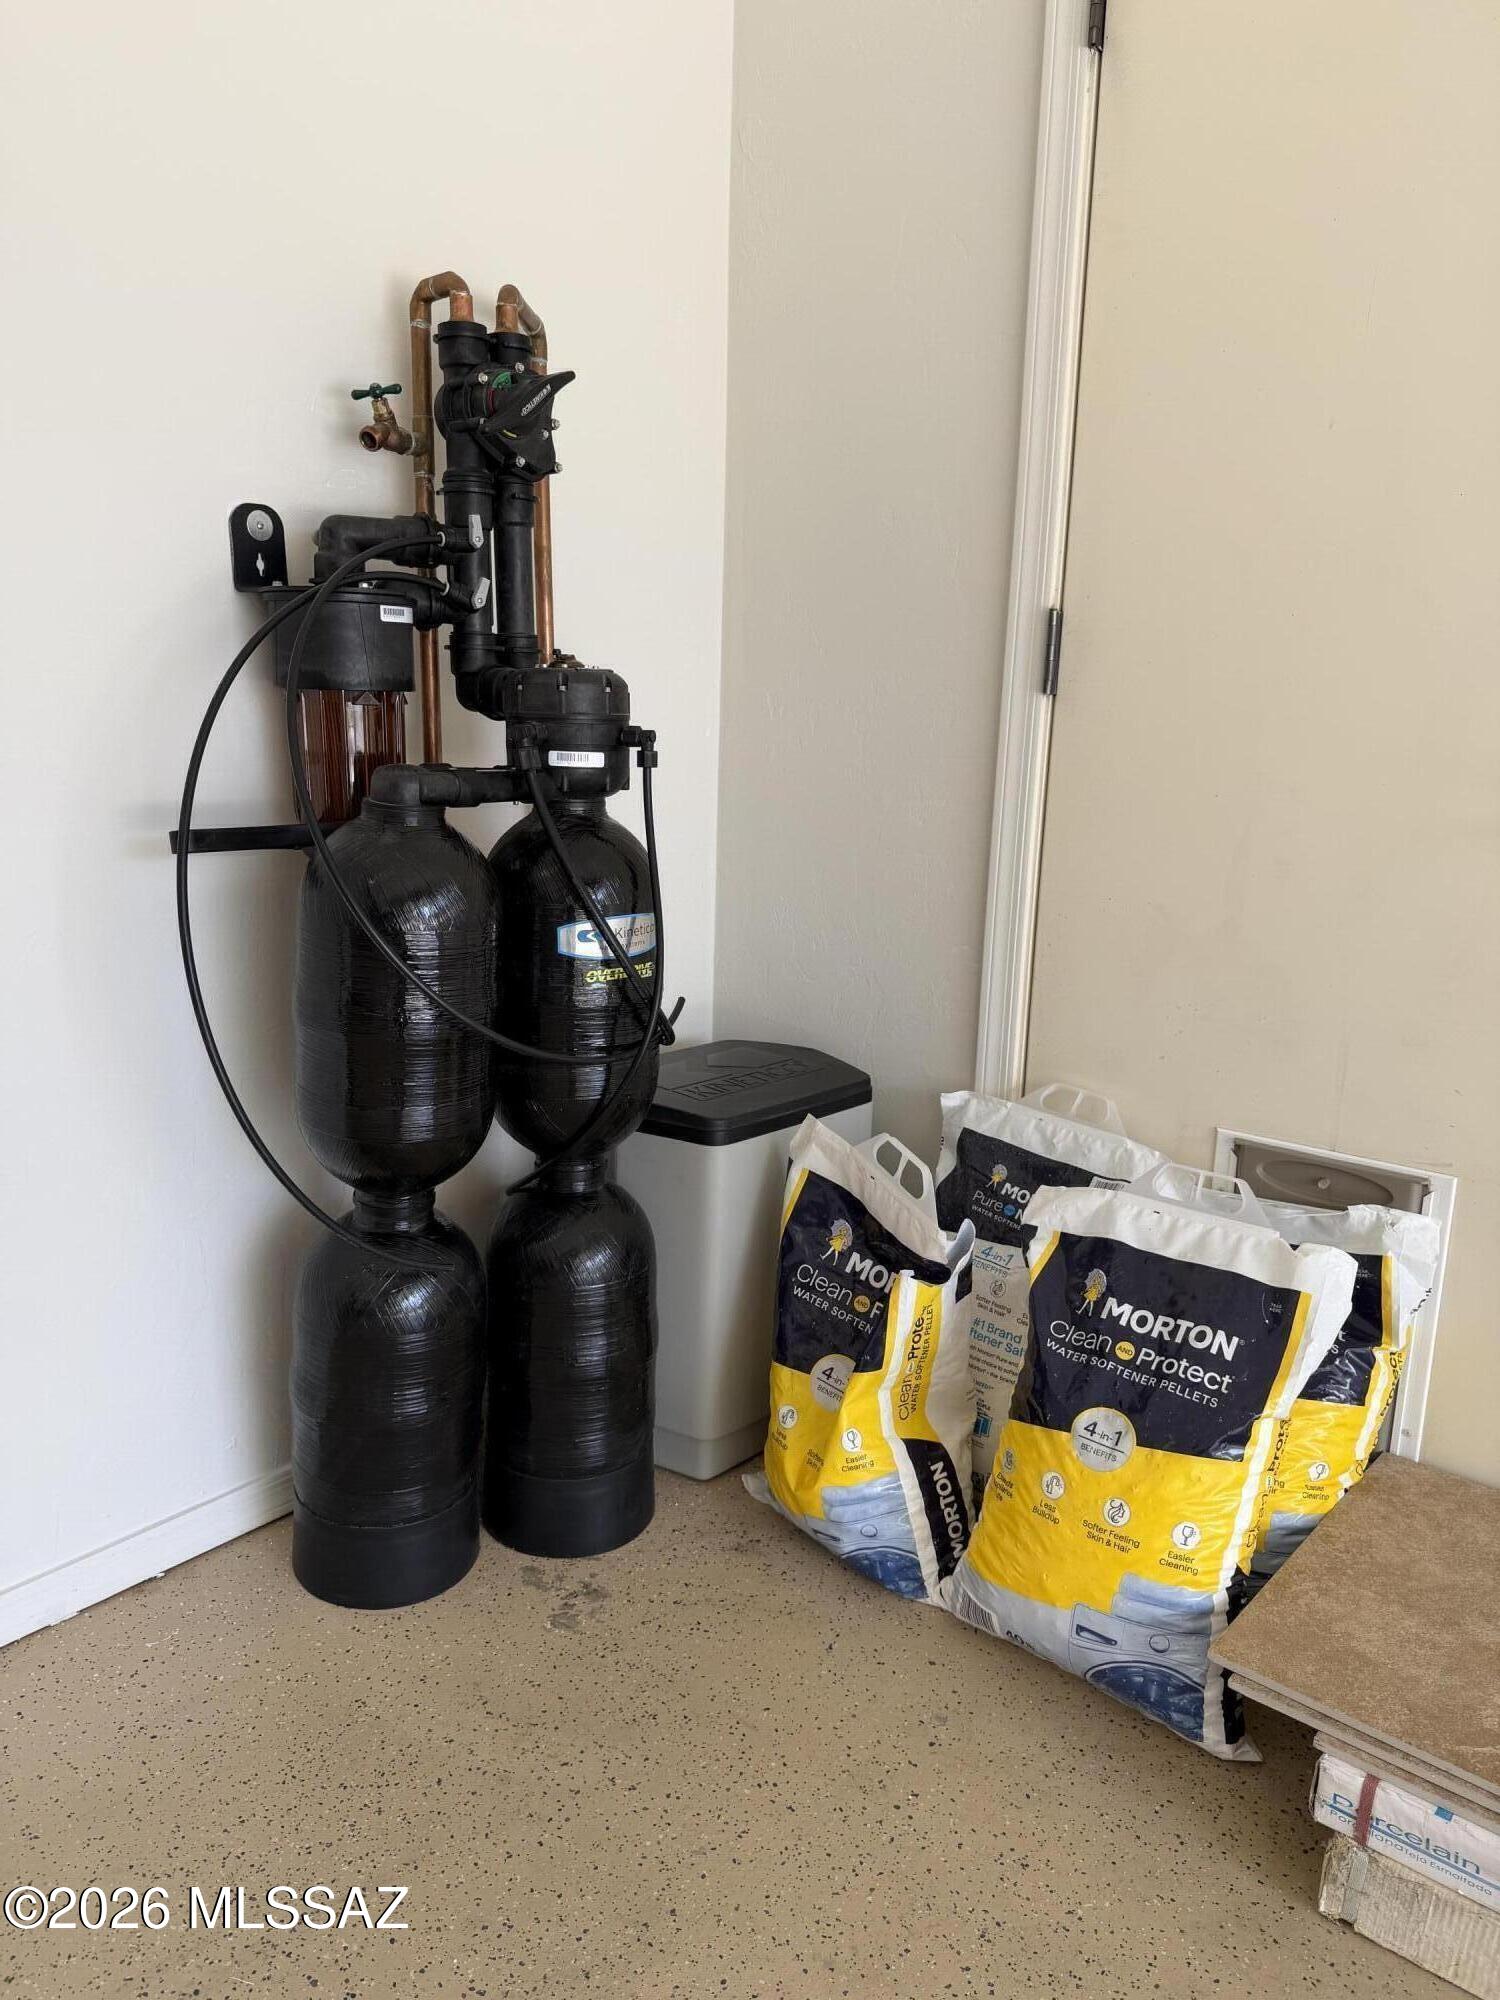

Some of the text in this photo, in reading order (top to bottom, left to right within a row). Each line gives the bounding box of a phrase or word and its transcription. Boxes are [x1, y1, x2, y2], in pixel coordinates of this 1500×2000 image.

[972, 1190, 1004, 1212] Pure
[797, 1264, 853, 1306] Clean
[793, 1286, 830, 1311] WATER
[986, 1322, 1023, 1344] Brand
[1050, 1320, 1113, 1354] Clean
[1135, 1347, 1232, 1394] Protect
[1046, 1337, 1088, 1364] WATER
[1089, 1355, 1157, 1387] SOFTENER
[1158, 1379, 1219, 1409] PELLETS
[1083, 1421, 1123, 1447] 4-in-1
[845, 1453, 868, 1464] Easier
[1080, 1442, 1117, 1462] BENEFITS
[841, 1460, 875, 1473] Cleaning
[930, 1461, 965, 1560] MORTON
[1082, 1519, 1141, 1549] Softer Feeling
[1086, 1531, 1131, 1555] Skin & Hair
[1158, 1557, 1199, 1576] Cleaning
[1167, 1550, 1196, 1564] Easier
[1330, 1793, 1481, 1876] Prcelain
